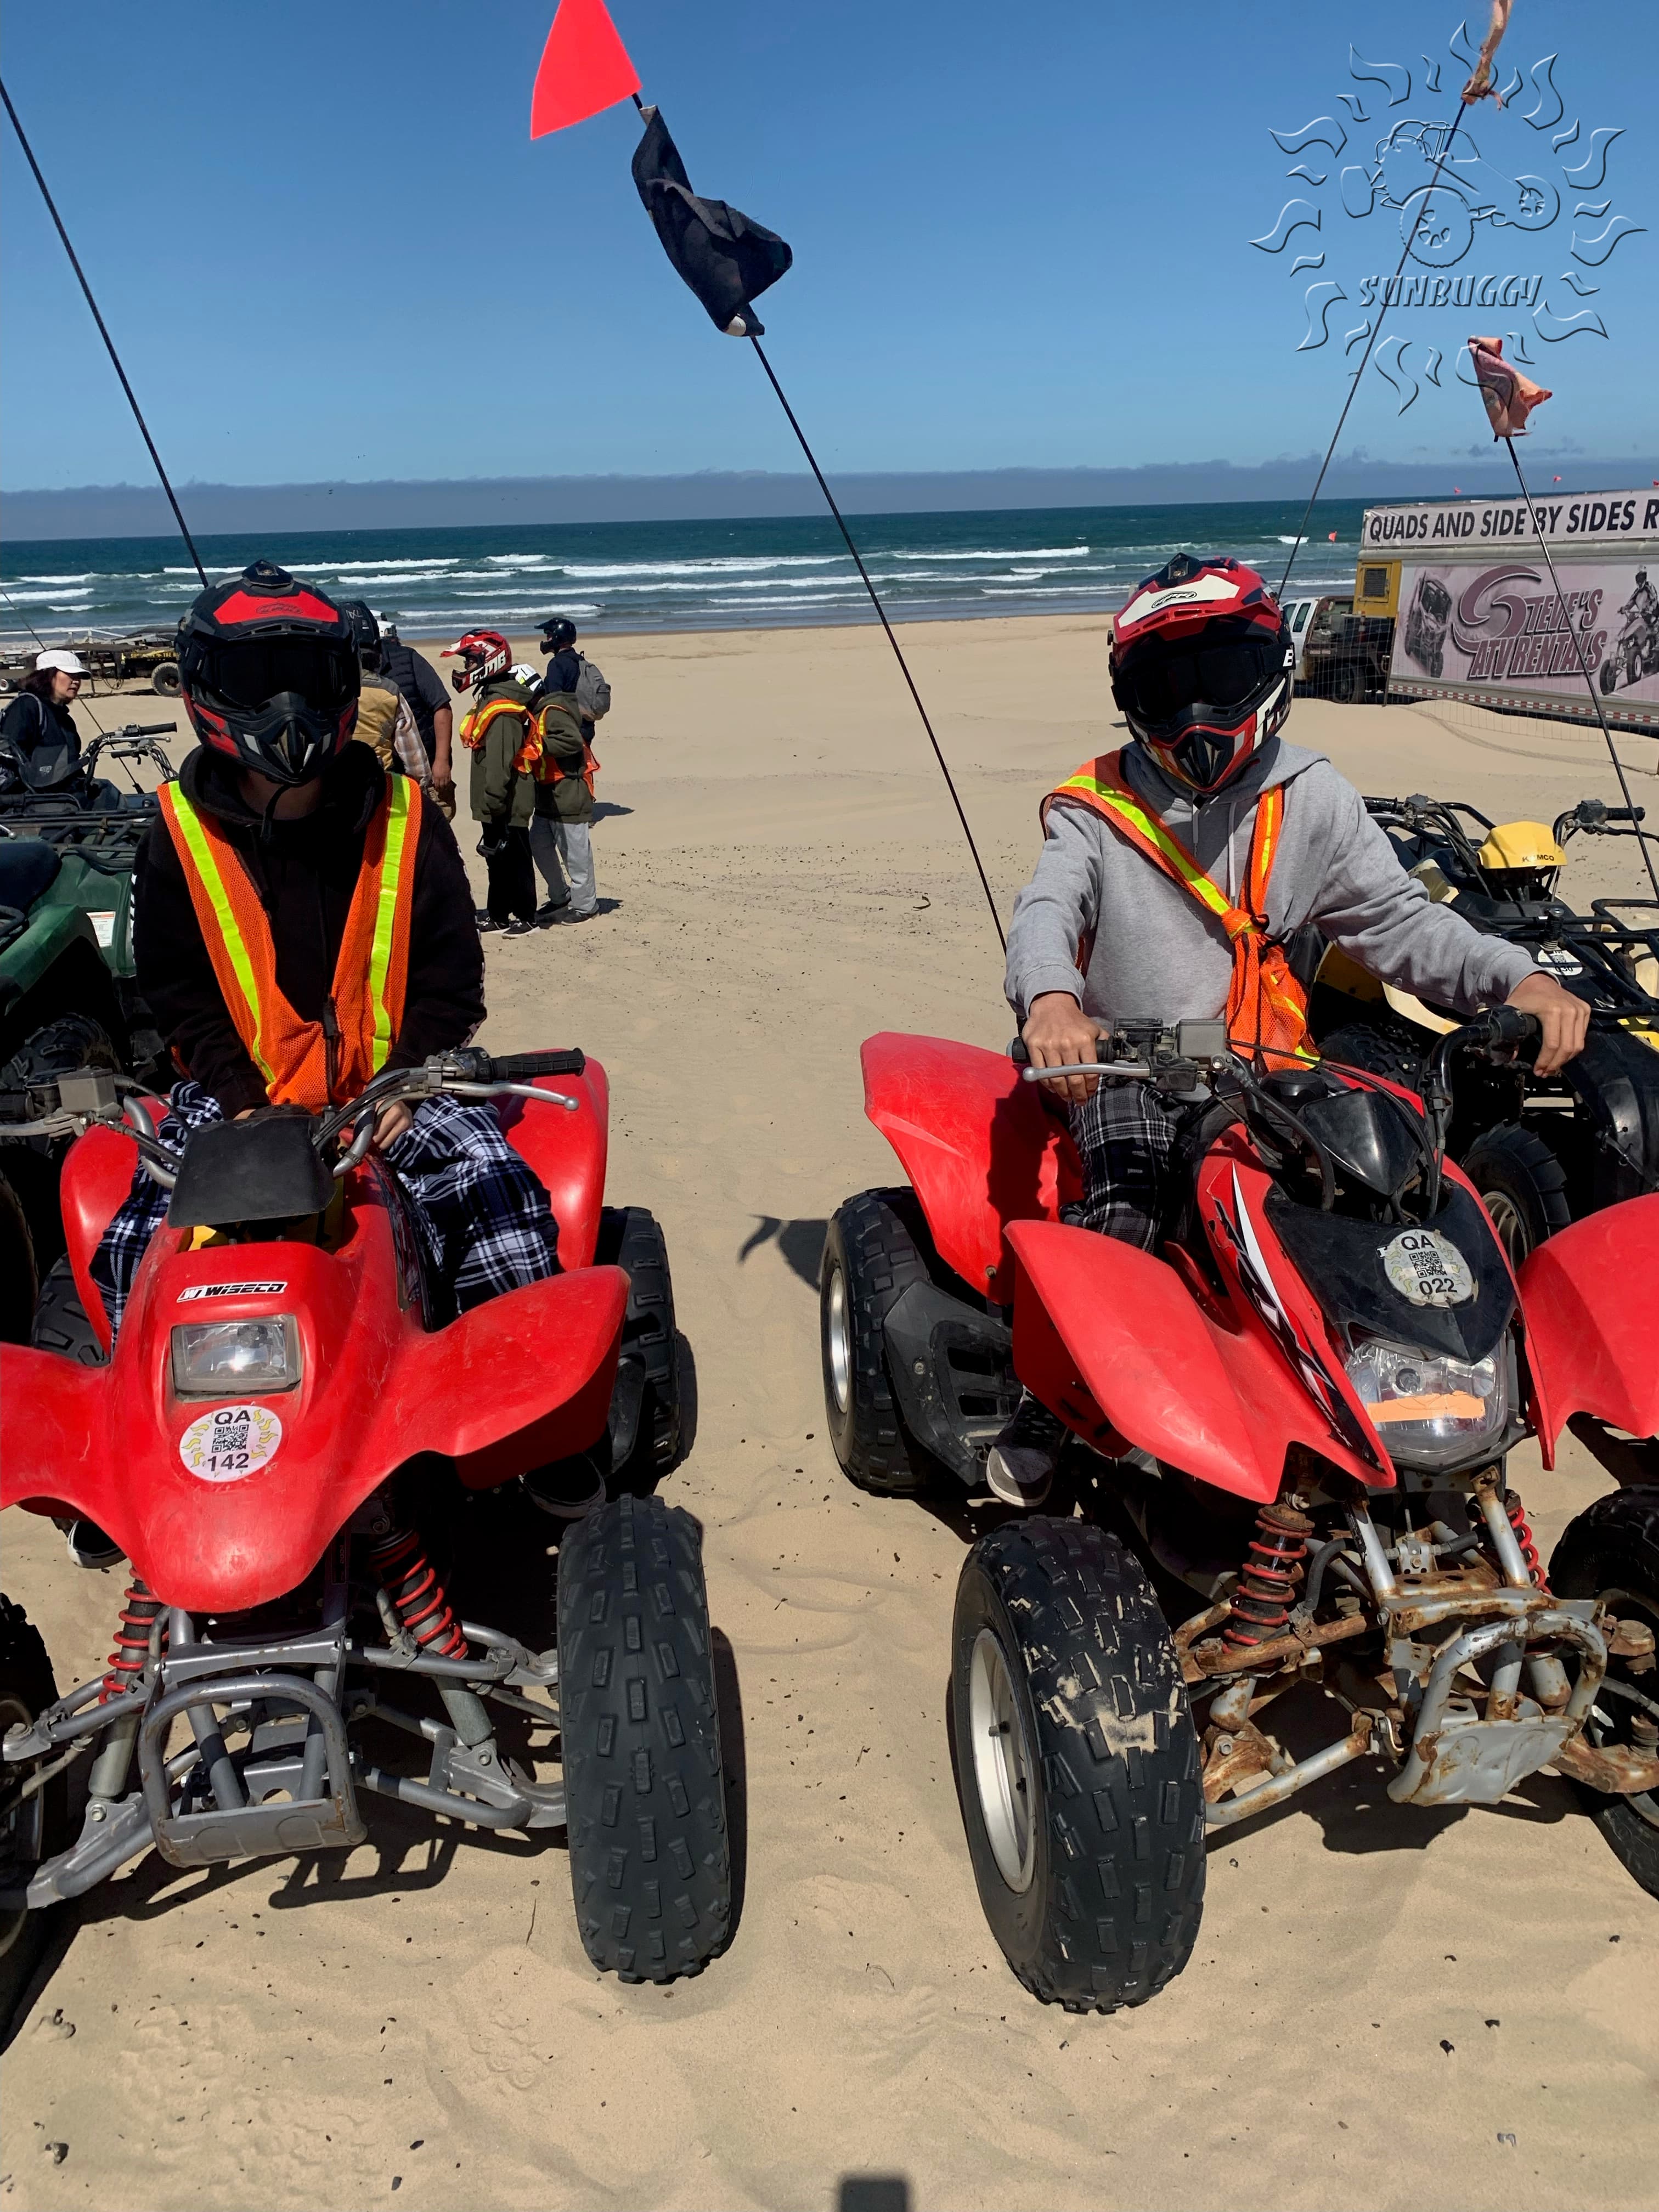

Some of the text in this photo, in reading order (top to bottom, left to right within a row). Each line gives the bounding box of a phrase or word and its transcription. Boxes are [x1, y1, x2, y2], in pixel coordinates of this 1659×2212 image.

[1370, 514, 1429, 542] QUADS
[1432, 512, 1475, 538] AND
[1480, 508, 1527, 537] SIDE
[1532, 505, 1563, 534] BY
[1566, 500, 1636, 533] SIDES
[1452, 565, 1603, 653] STEVE'S
[1469, 630, 1608, 678] ATV RENTALS
[1522, 854, 1555, 863] KMCO
[1401, 1234, 1435, 1250] QA
[1419, 1278, 1458, 1295] 022
[215, 1410, 251, 1425] QA
[207, 1453, 249, 1471] 142
